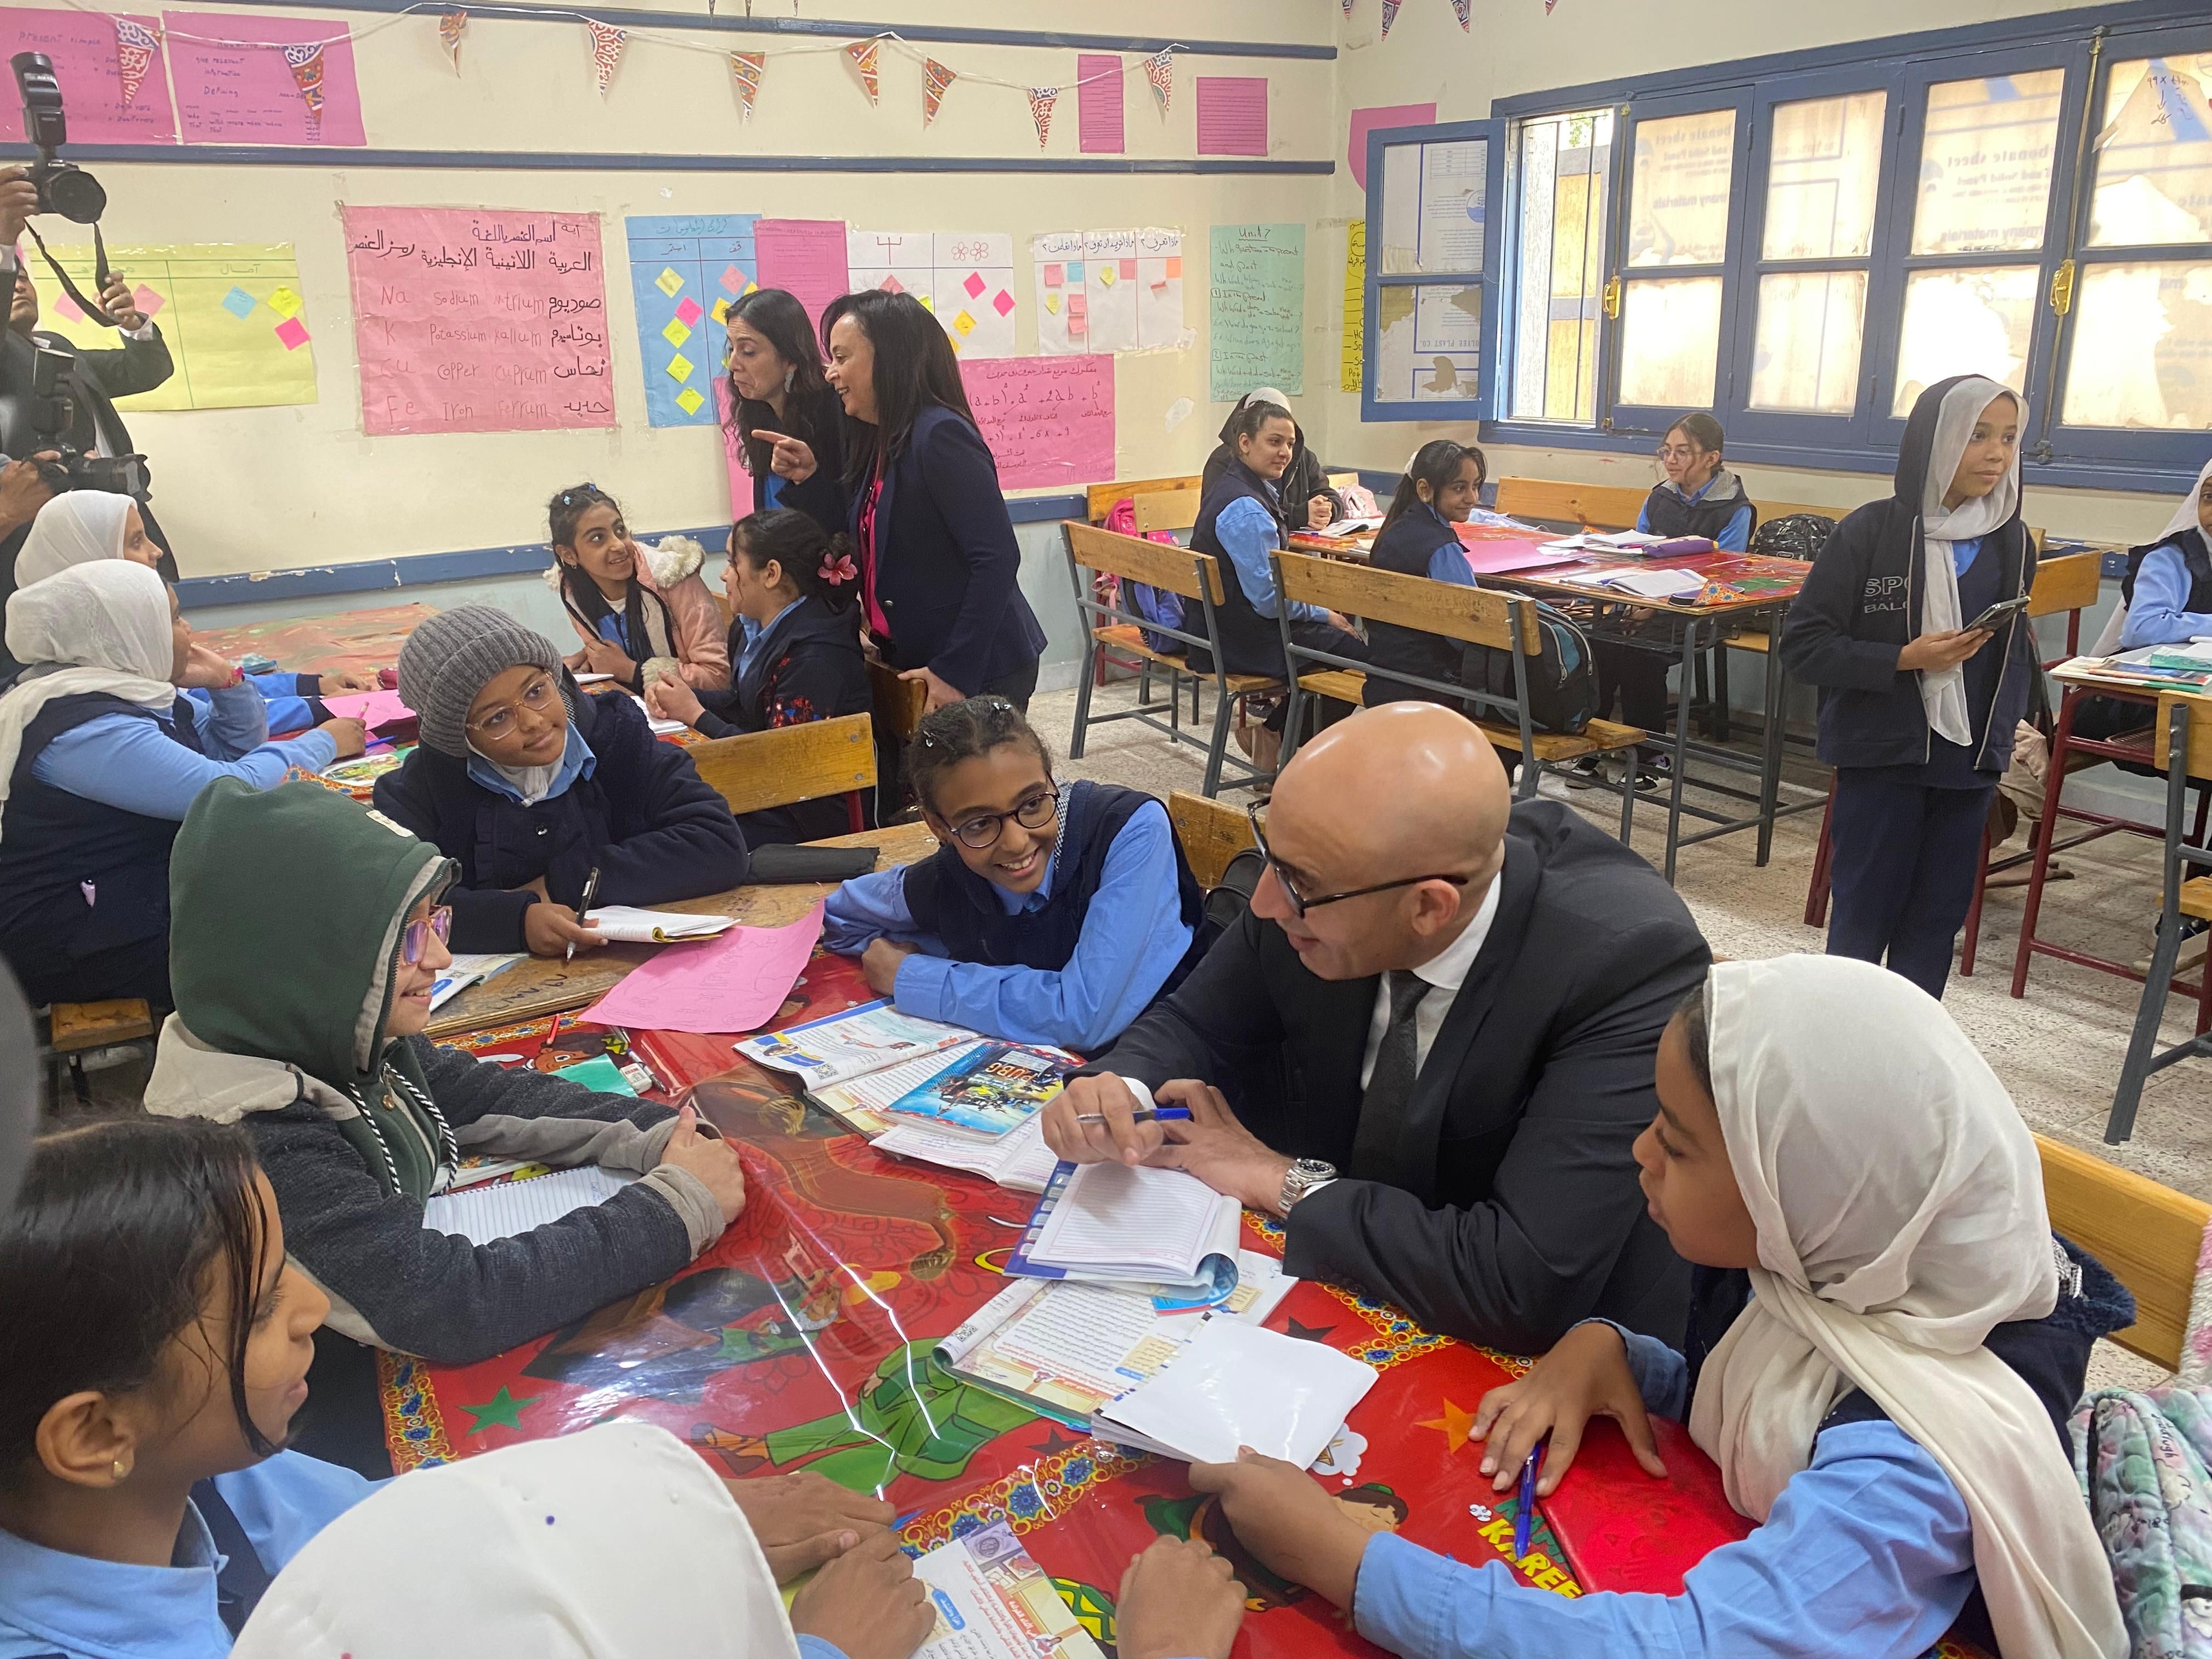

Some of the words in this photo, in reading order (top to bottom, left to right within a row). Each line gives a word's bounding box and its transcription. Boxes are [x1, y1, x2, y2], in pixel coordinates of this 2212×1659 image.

[1239, 225, 1261, 238] Unit
[377, 240, 415, 258] رمز
[549, 251, 591, 274] العربية
[381, 286, 411, 305] Na
[433, 291, 479, 306] Sodium
[386, 320, 396, 346] K
[430, 324, 486, 346] Potassium
[381, 358, 416, 379] Cu
[554, 356, 605, 377] نحاس
[387, 396, 419, 425] Fe
[442, 402, 473, 421] Iron
[1864, 576, 1909, 596] SP
[985, 1062, 1039, 1083] PUBG
